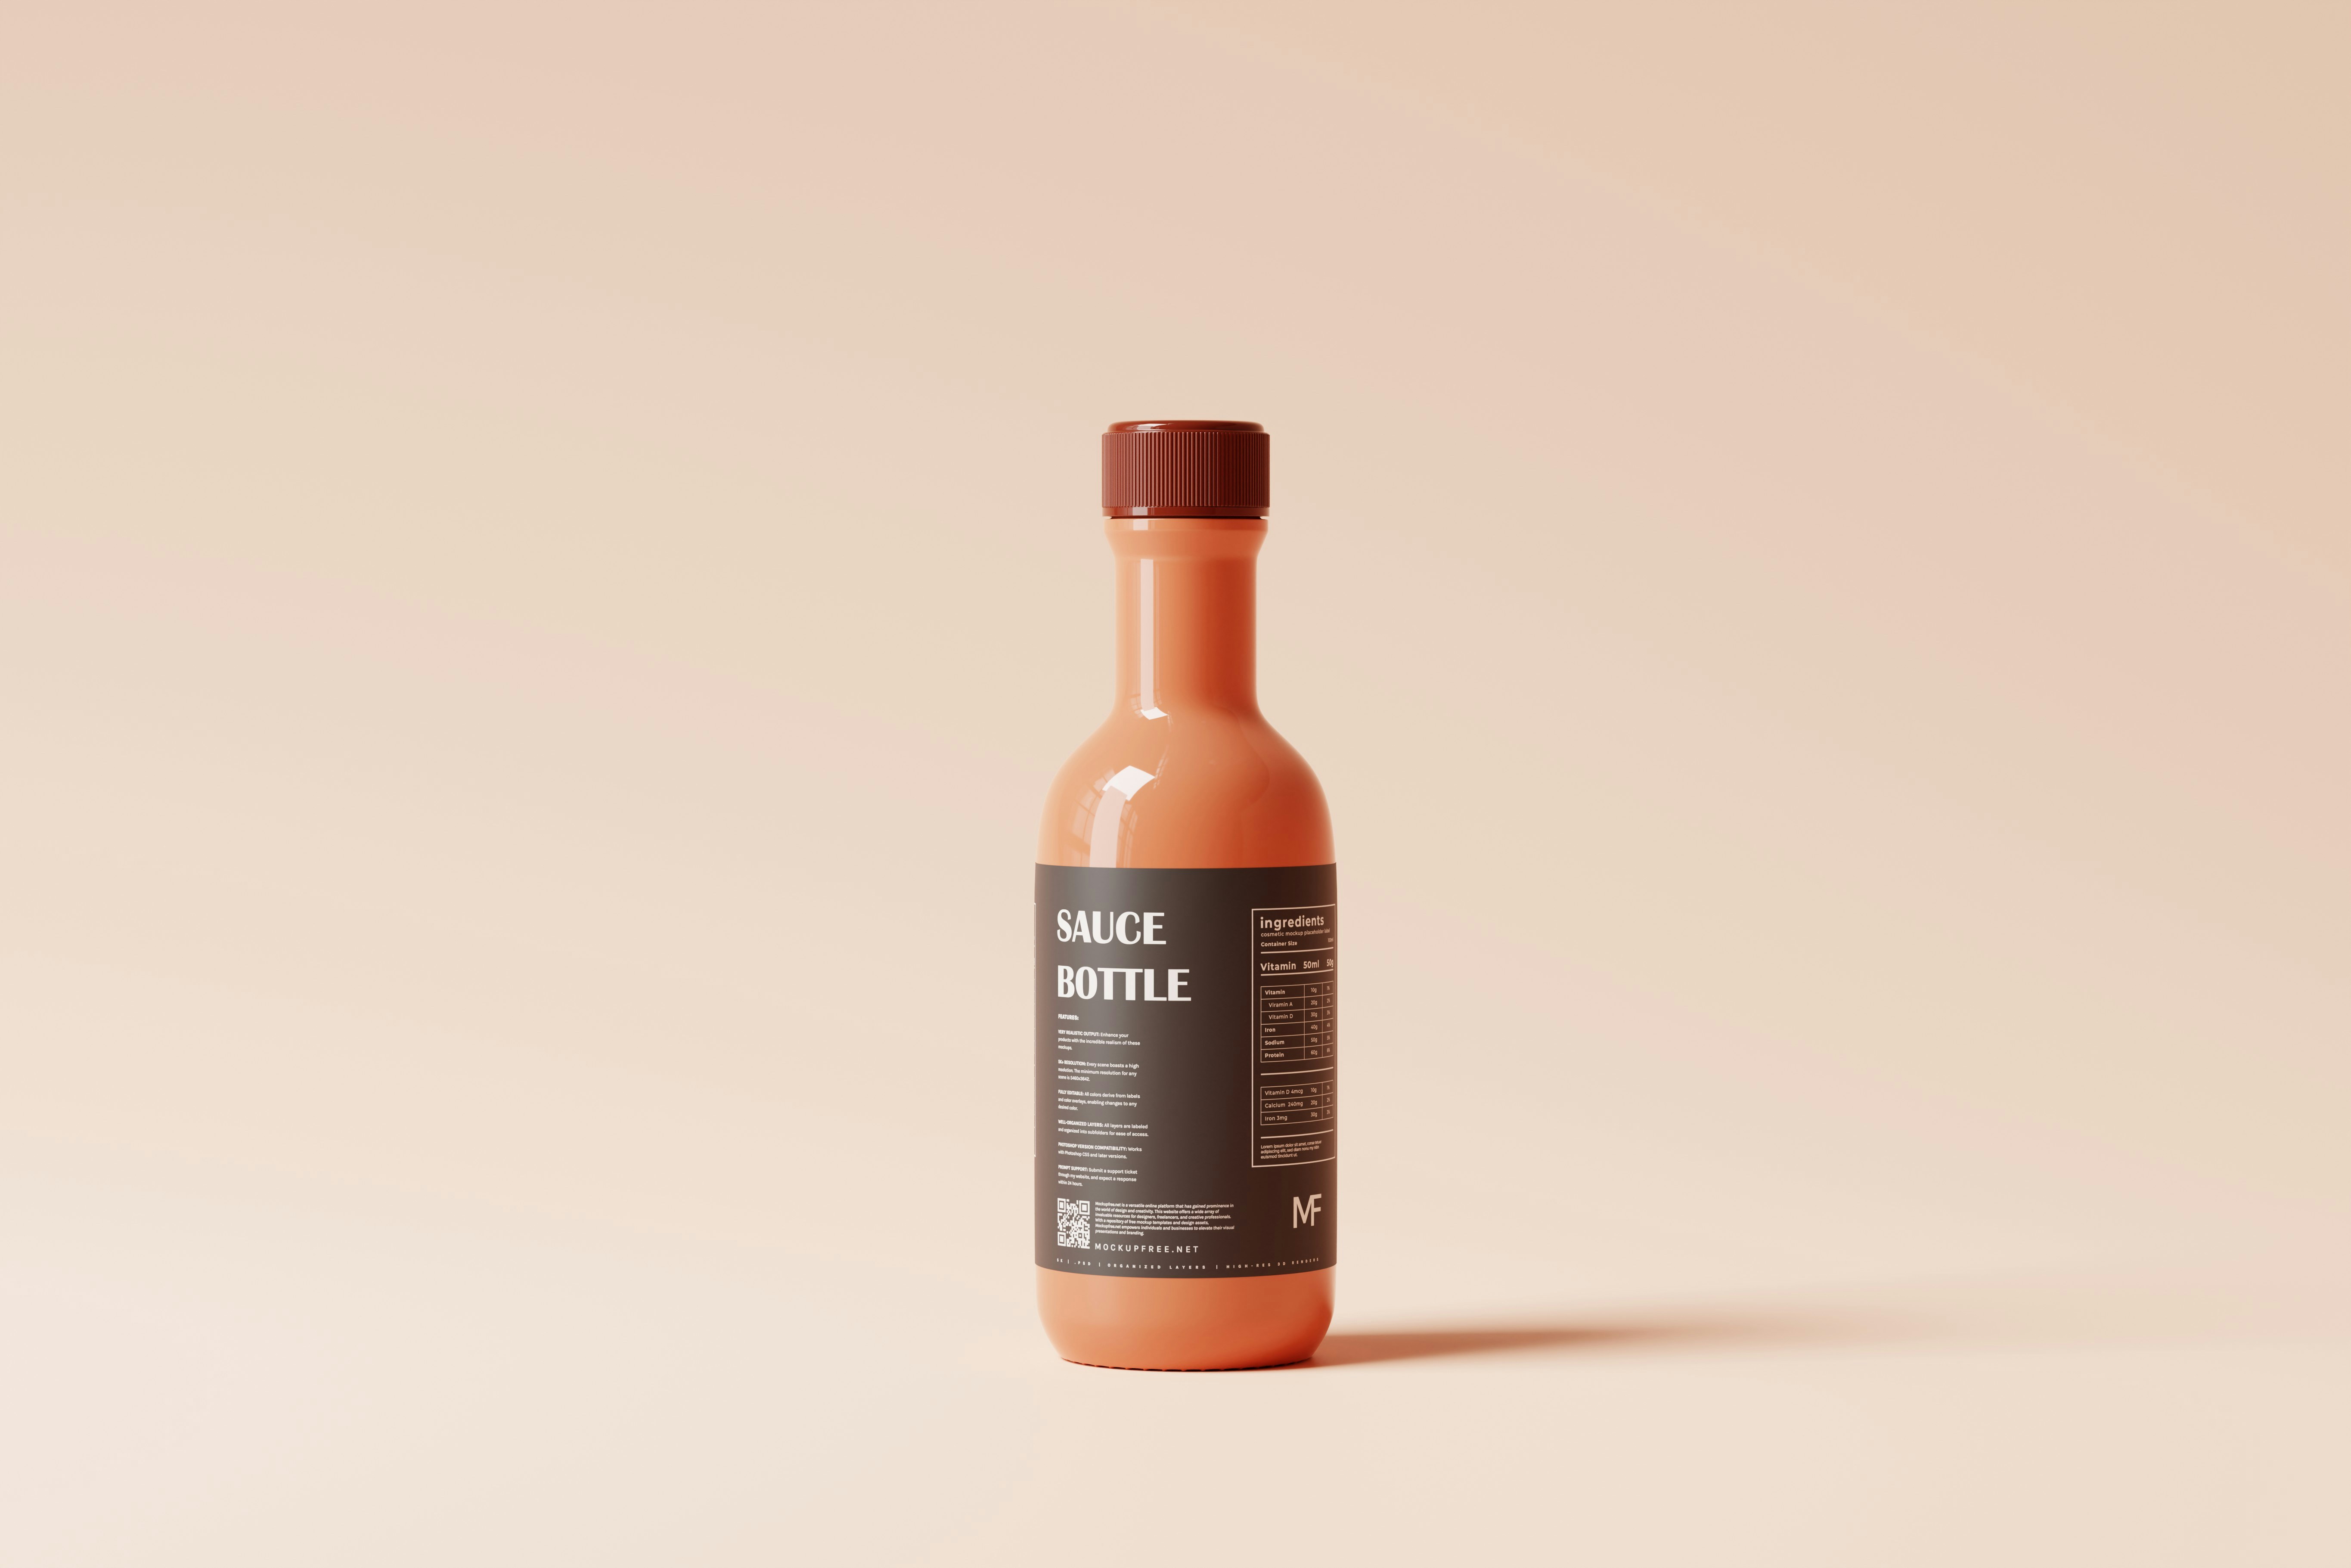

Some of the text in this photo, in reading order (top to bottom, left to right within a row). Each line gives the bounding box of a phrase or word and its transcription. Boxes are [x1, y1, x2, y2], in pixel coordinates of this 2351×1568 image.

[1057, 909, 1166, 945] SAUCE
[1261, 915, 1324, 930] ingredients
[1260, 962, 1296, 970] Vitamin
[1303, 960, 1319, 969] 50ml
[1058, 965, 1191, 1001] BOTTLE
[1293, 1193, 1321, 1228] MF
[1095, 1243, 1198, 1252] MOCKUPFREE.NET
